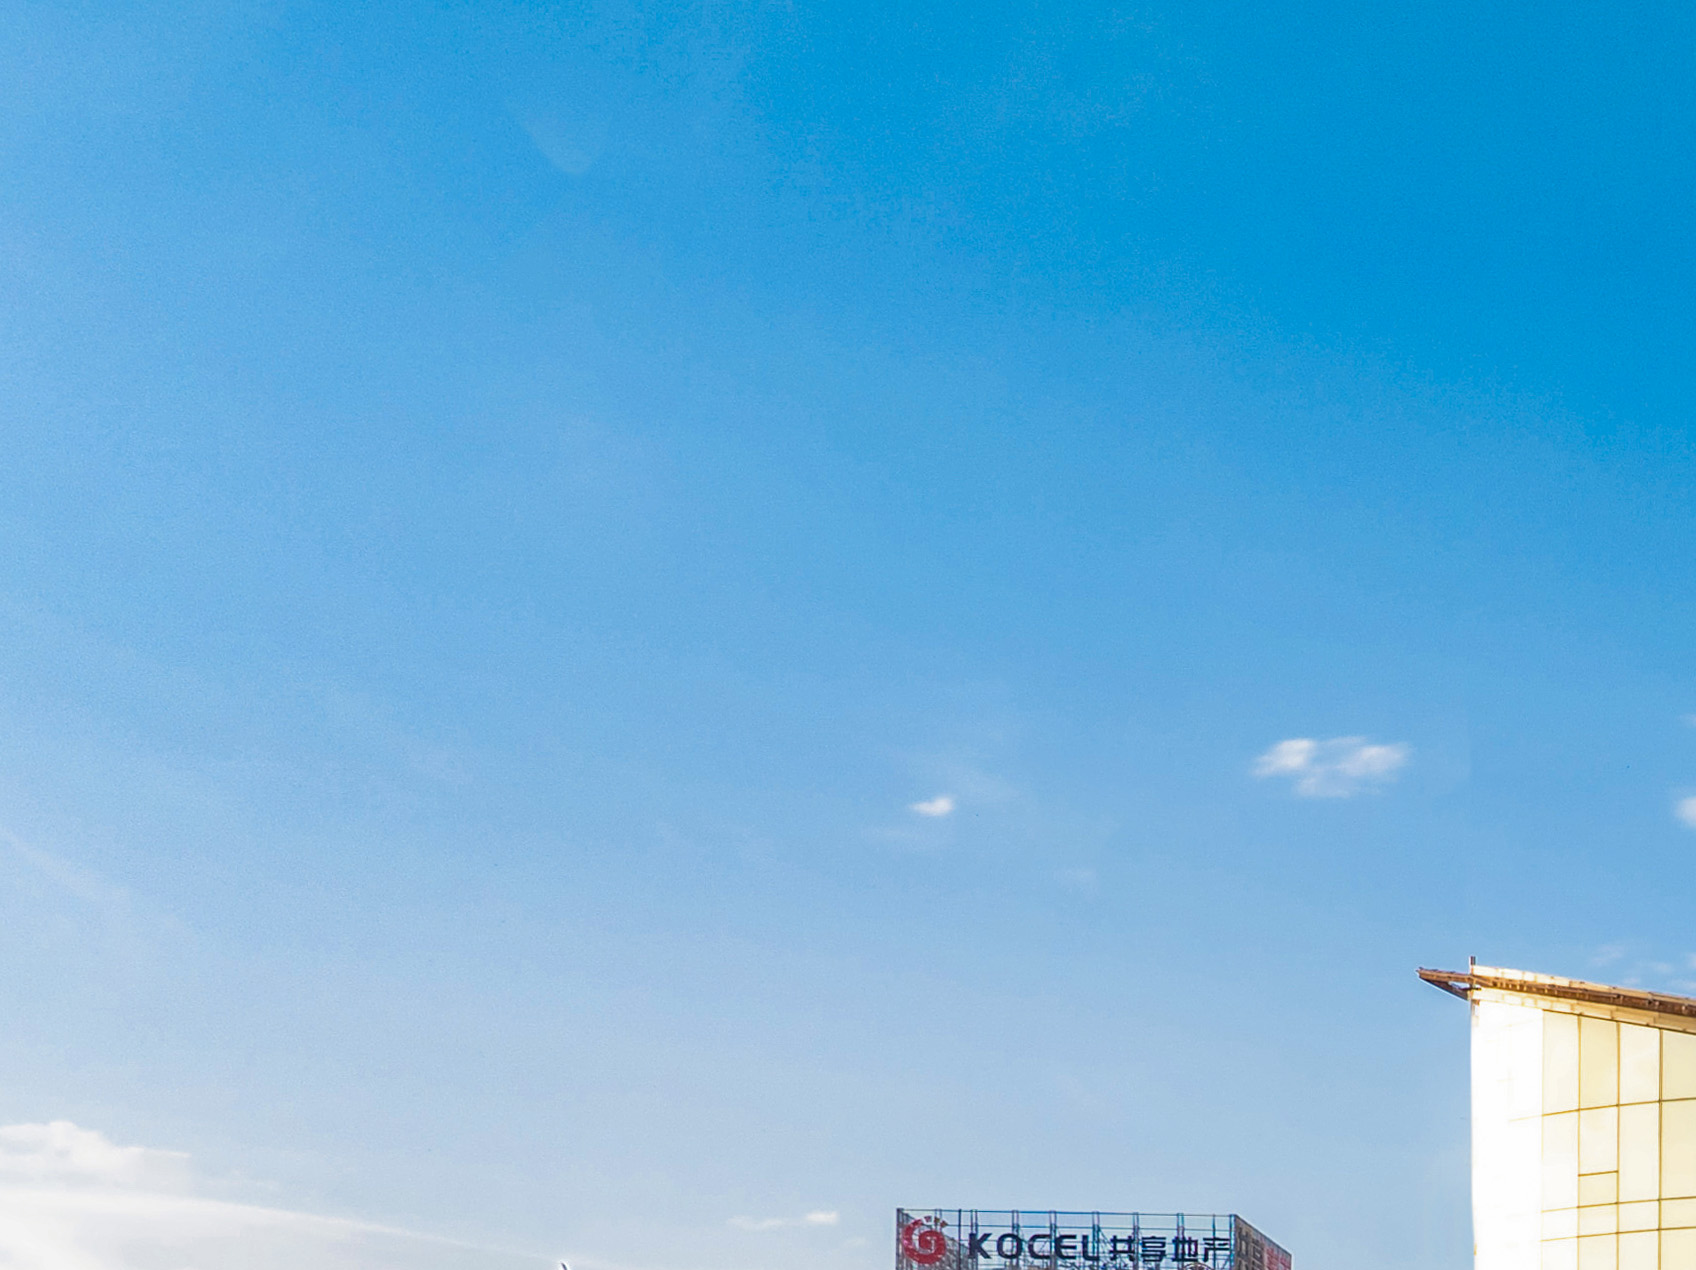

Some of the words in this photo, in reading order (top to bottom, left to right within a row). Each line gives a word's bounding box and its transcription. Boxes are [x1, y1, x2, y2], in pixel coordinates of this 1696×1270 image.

[968, 1232, 1100, 1261] KOCEL
[1109, 1234, 1231, 1264] 共享地产
